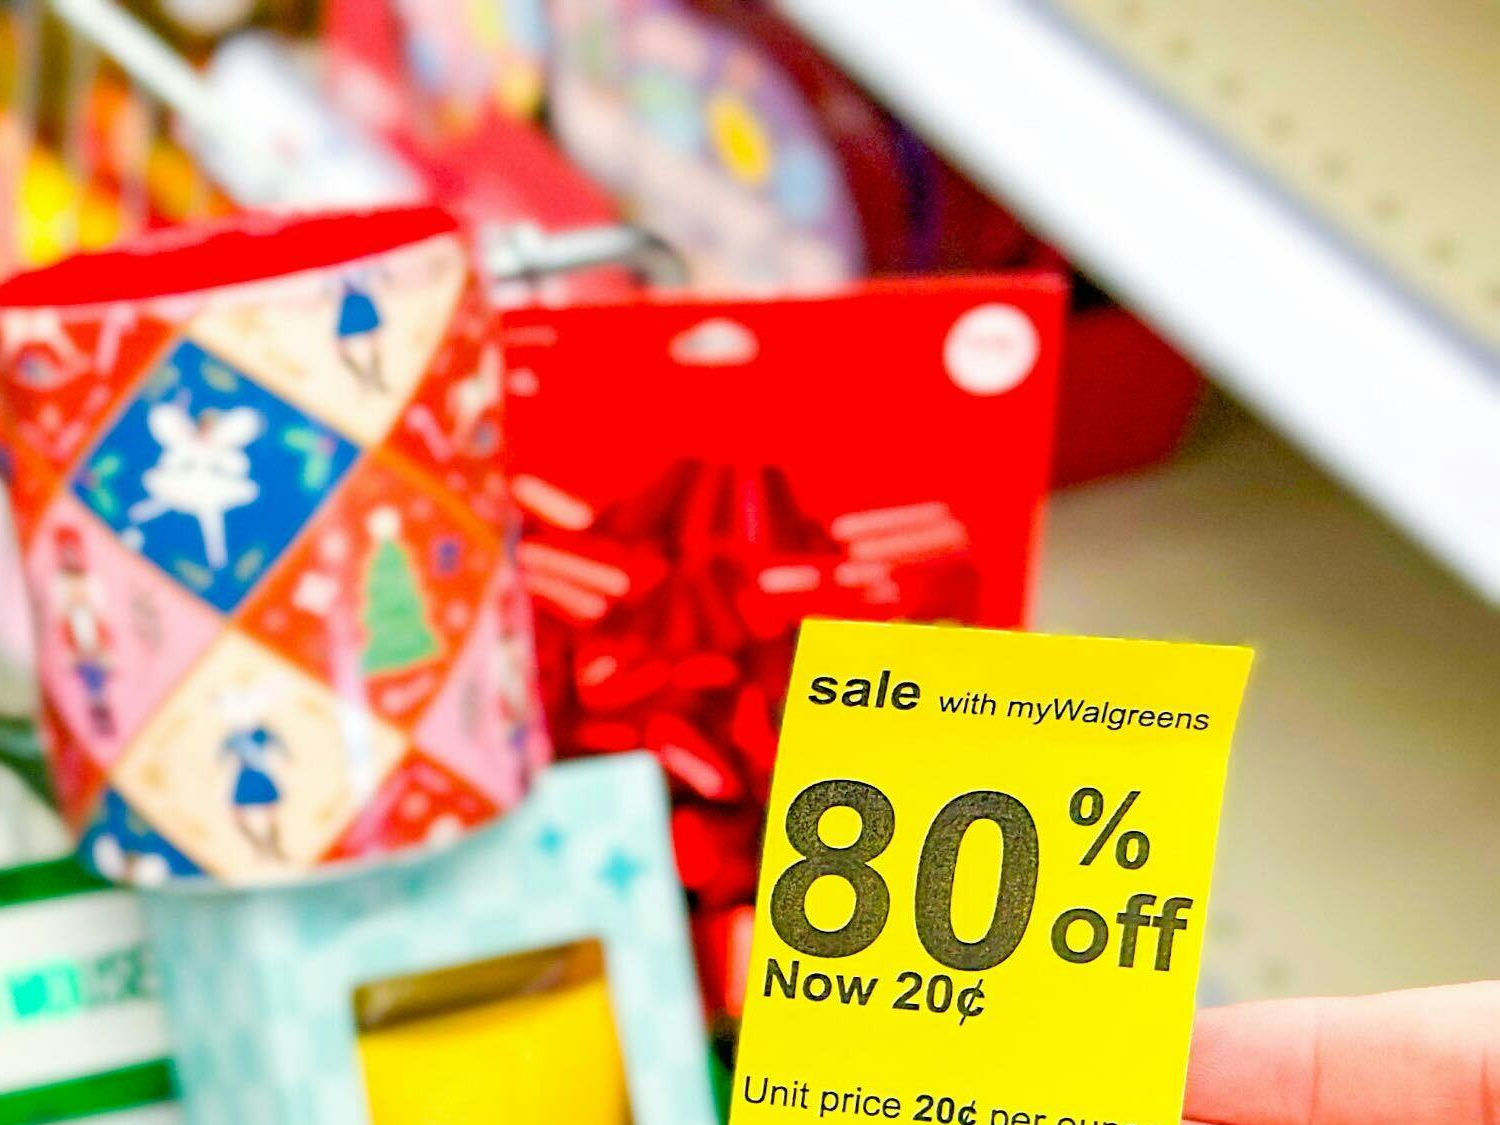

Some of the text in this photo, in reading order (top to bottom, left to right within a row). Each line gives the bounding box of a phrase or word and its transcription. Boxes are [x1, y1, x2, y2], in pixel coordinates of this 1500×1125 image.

[808, 670, 1210, 732] sale with myWalgreens
[770, 779, 1150, 971] 80 %
[1051, 894, 1193, 971] off
[763, 958, 985, 1026] Now 20¢
[744, 1076, 808, 1111] Unit
[820, 1087, 901, 1119] price
